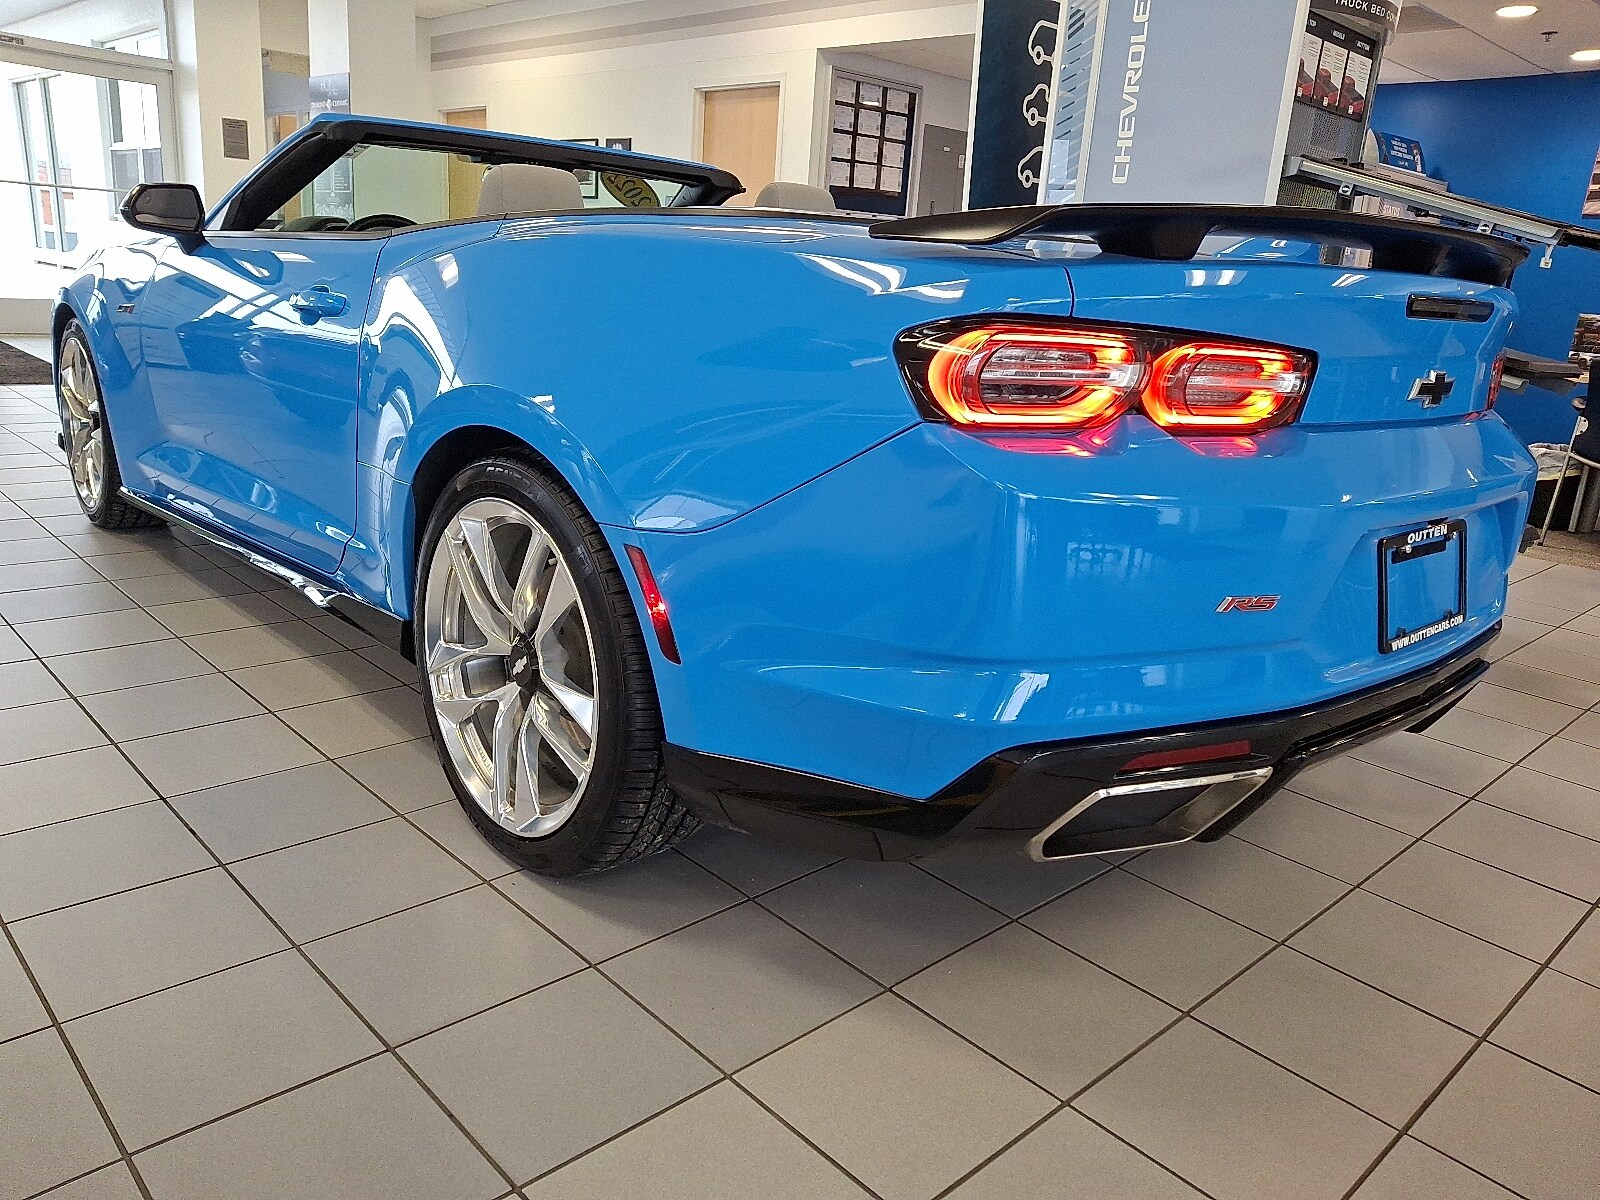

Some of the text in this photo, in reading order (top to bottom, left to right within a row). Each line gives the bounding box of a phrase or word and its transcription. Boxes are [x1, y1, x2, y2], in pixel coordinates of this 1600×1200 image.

[1371, 4, 1386, 17] BED
[1407, 524, 1448, 544] OUTTEN
[1214, 595, 1281, 613] RS
[1391, 614, 1464, 652] WWW.OUTTENCARS.COM
